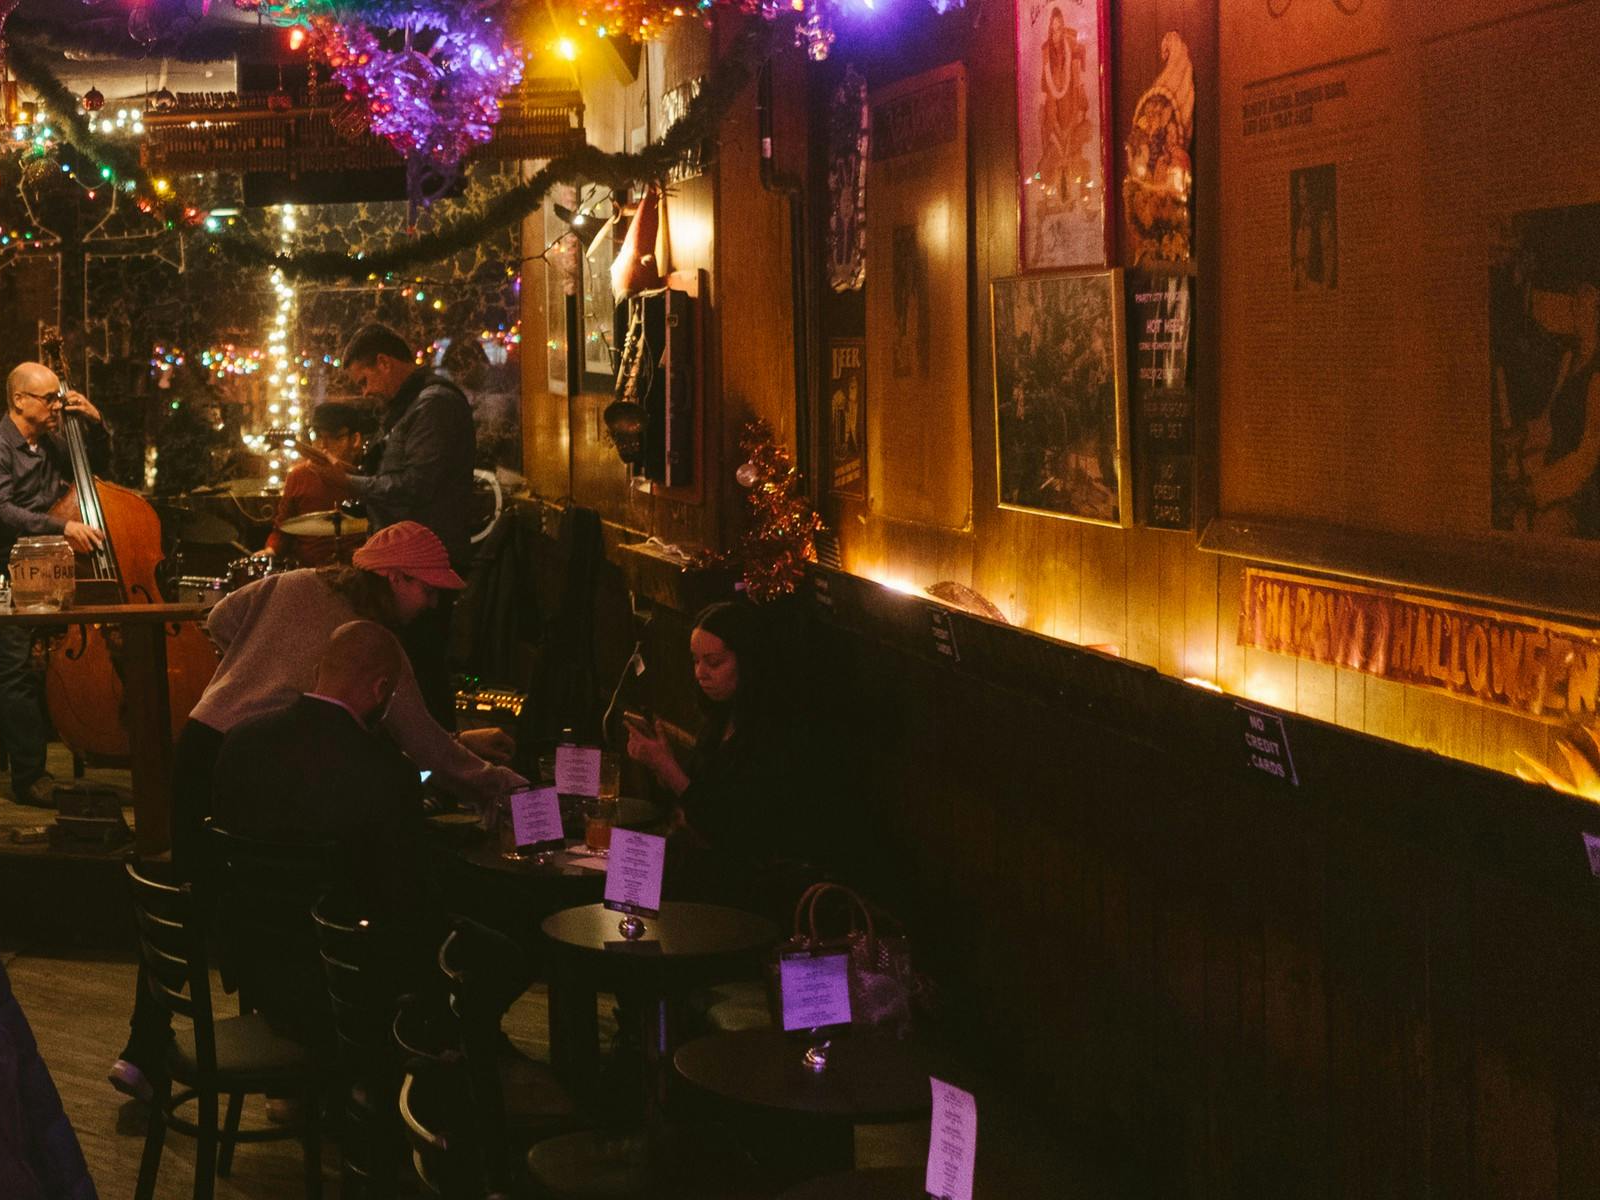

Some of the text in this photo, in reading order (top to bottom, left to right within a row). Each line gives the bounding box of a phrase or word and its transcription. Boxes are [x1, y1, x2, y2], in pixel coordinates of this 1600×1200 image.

[12, 562, 40, 580] TIP
[1392, 605, 1599, 714] HALLOWEEN
[1248, 714, 1265, 732] NO
[1244, 731, 1280, 757] CREDIT
[1251, 753, 1286, 778] CARDS
